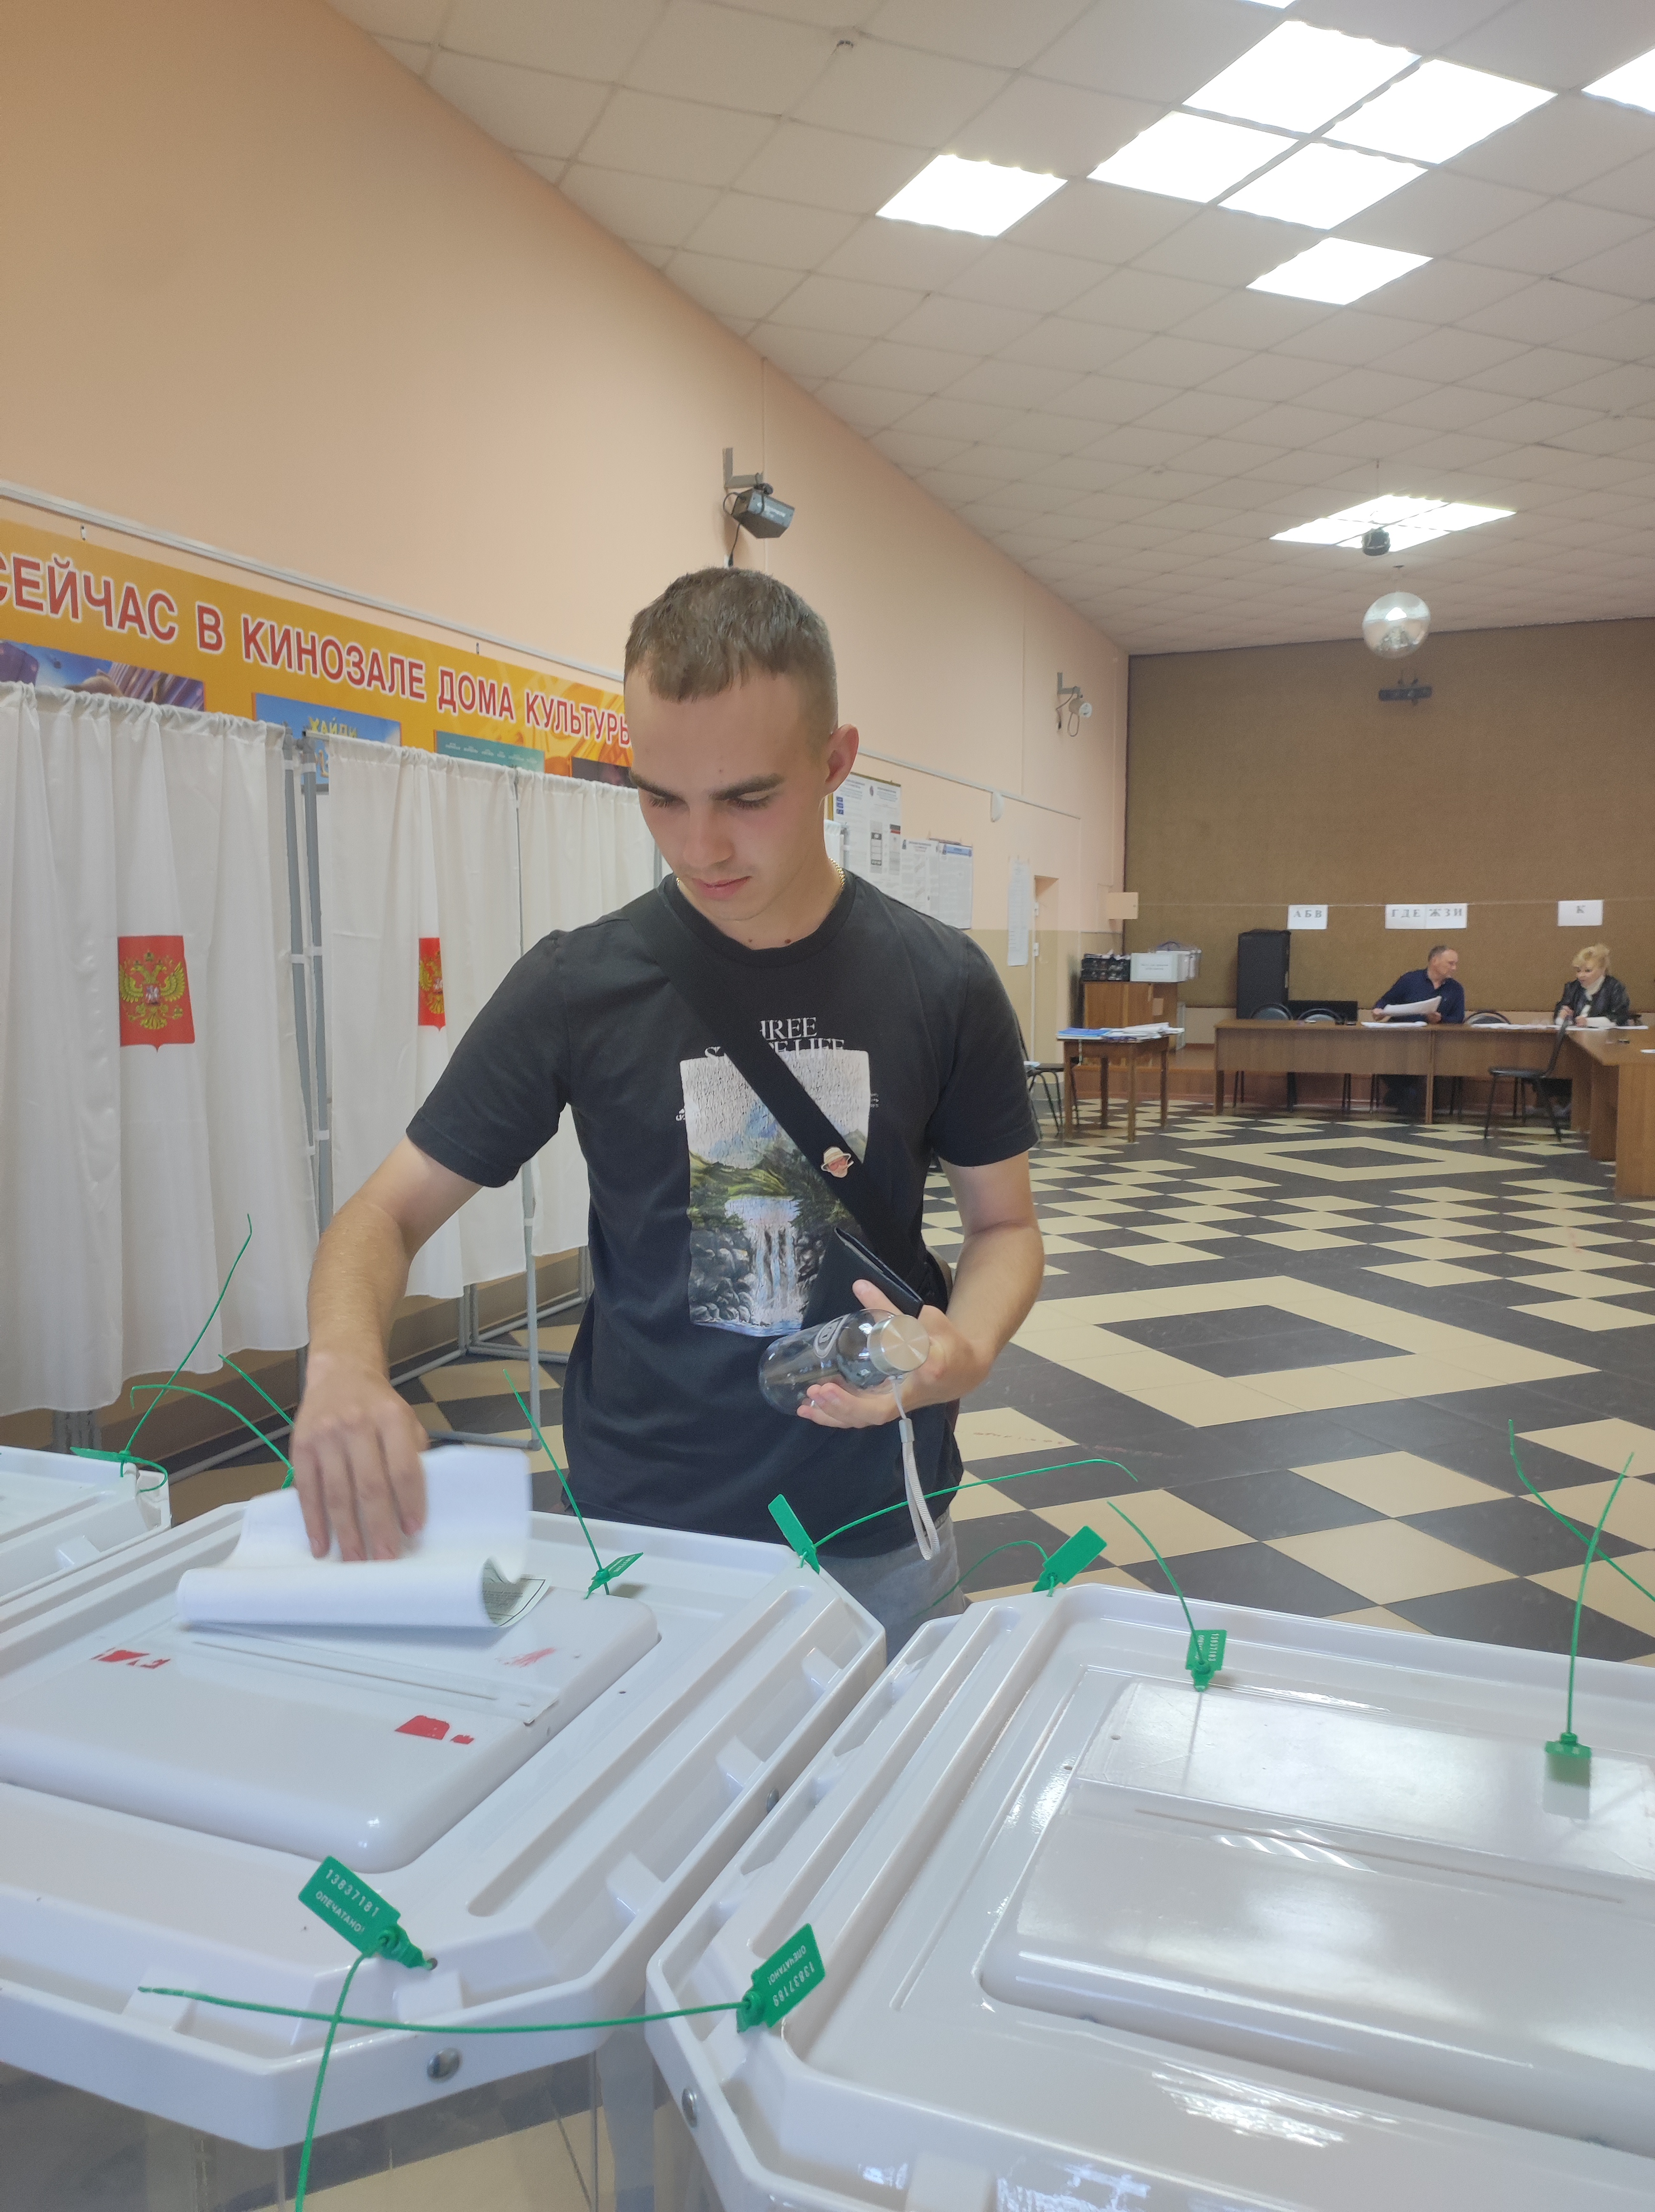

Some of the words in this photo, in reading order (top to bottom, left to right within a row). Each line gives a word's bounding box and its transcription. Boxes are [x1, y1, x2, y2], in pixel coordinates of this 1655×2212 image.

[0, 553, 177, 642] ЕЙЧАС
[195, 603, 224, 653] В
[241, 615, 426, 701] КИНОЗАЛЕ
[438, 668, 515, 721] ДОМА
[325, 1869, 380, 1917] 13837181
[767, 1945, 807, 1986] ОПЕЧАТАНО!
[772, 1961, 815, 2007] 13837189
